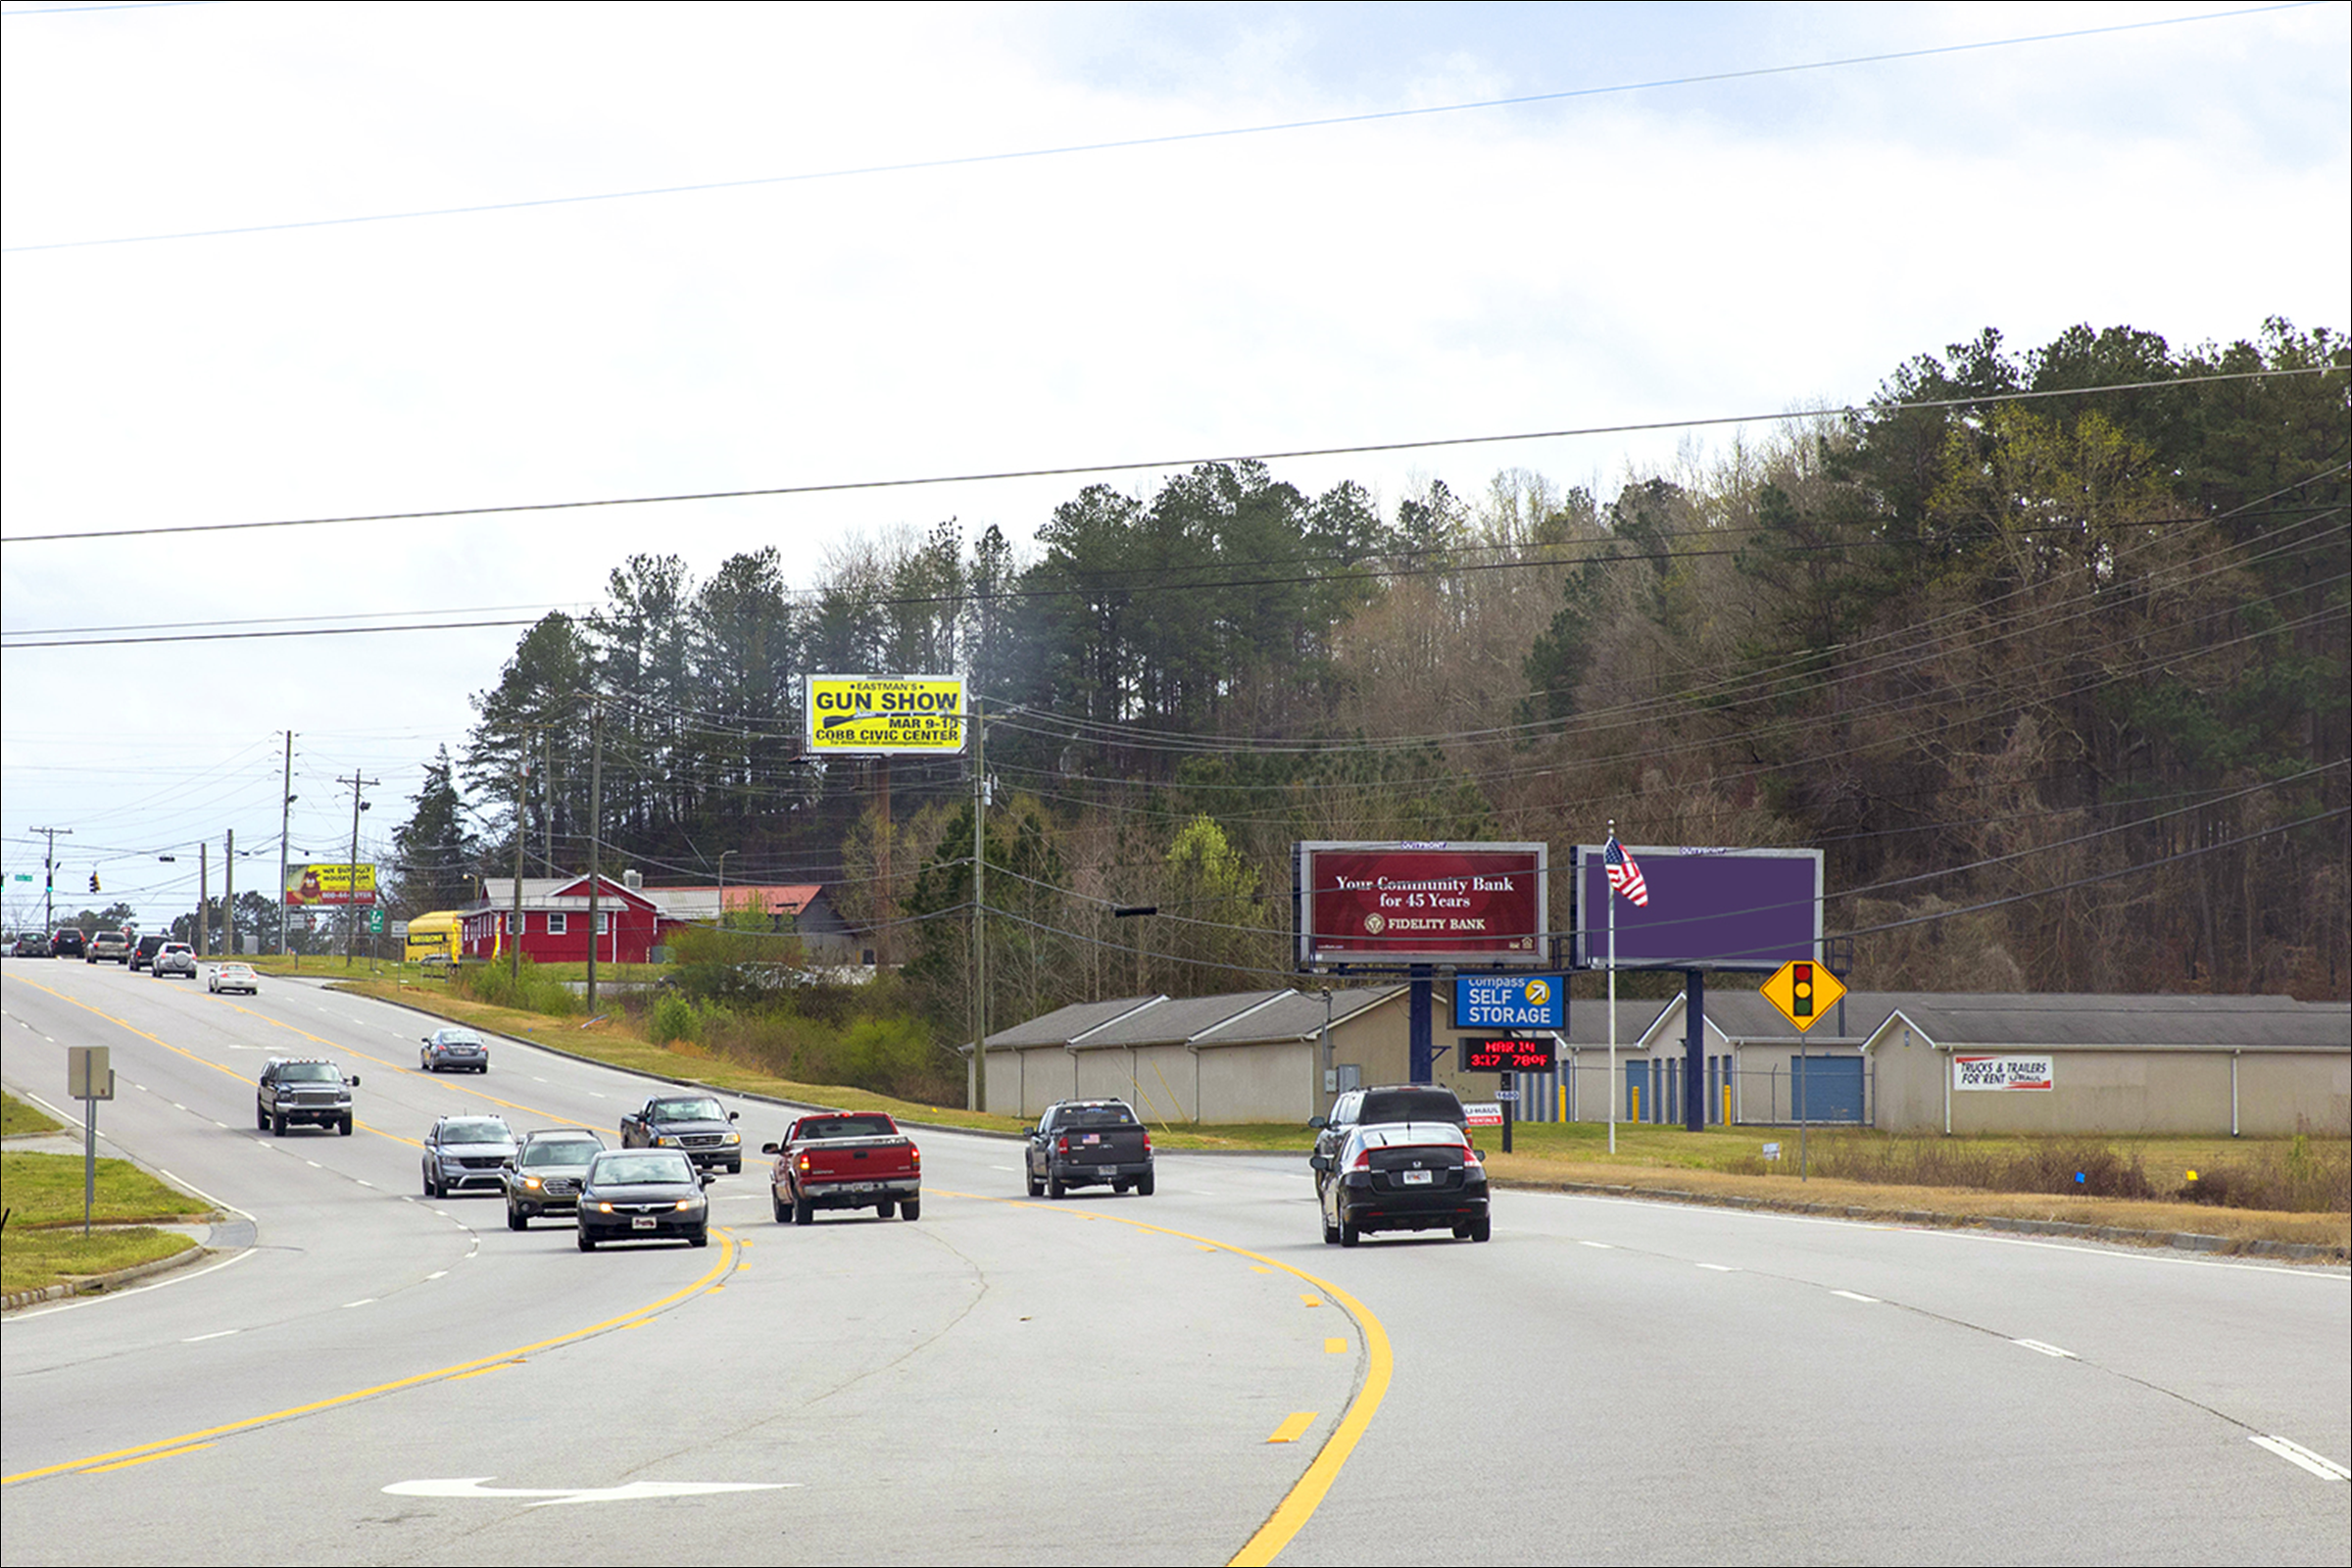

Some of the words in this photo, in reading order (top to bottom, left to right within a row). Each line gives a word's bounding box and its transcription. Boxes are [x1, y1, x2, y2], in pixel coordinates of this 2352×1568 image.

[816, 692, 871, 710] GUN
[881, 692, 957, 710] SHOW
[889, 718, 921, 729] MAR
[815, 729, 856, 741] COBB
[859, 729, 898, 741] CIVIC
[903, 729, 958, 742] CENTER
[1336, 875, 1374, 890] Your
[1377, 876, 1468, 896] Community
[1473, 876, 1514, 891] Bank
[1380, 893, 1402, 907] for
[1405, 893, 1425, 907] 45
[1429, 893, 1471, 907] Years
[1388, 918, 1446, 930] FIDELITY
[1449, 918, 1486, 930] BANK
[1469, 988, 1512, 1004] SELF
[1469, 1006, 1551, 1023] STORAGE
[1485, 1041, 1515, 1054] MAR
[1518, 1041, 1536, 1054] 14
[1471, 1054, 1501, 1066] 3:17
[1961, 1062, 1993, 1073] TRUCKS
[1996, 1062, 2003, 1073] &
[2006, 1062, 2047, 1074] TRAILERS
[1962, 1073, 1980, 1084] FOR
[1983, 1074, 2006, 1084] RENT
